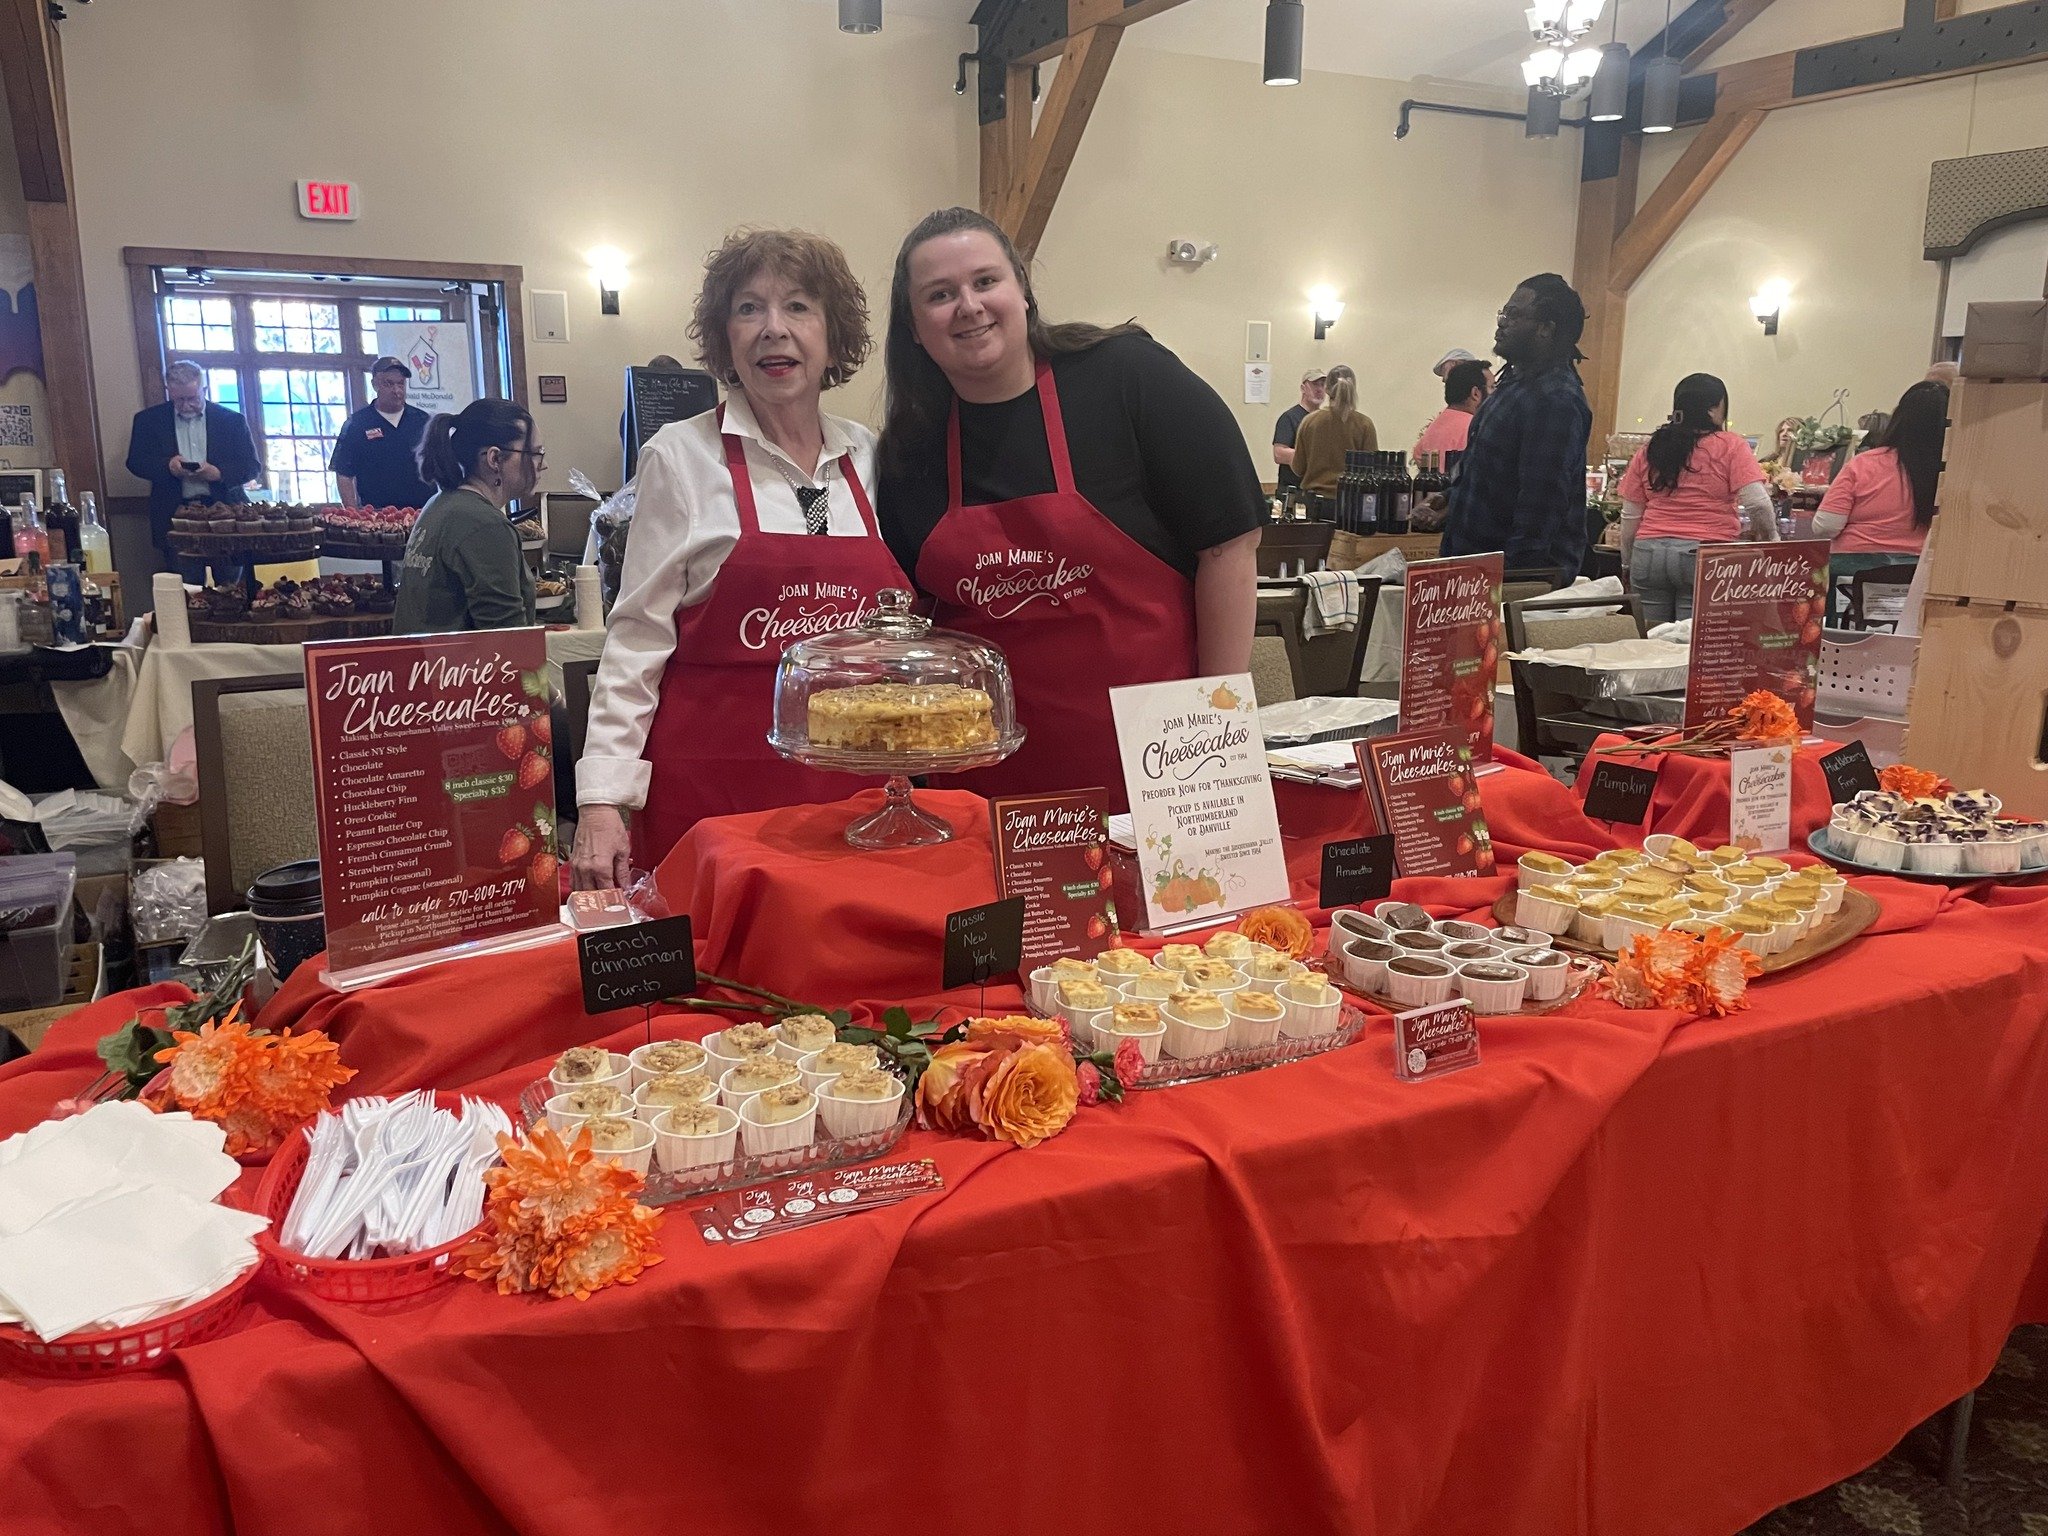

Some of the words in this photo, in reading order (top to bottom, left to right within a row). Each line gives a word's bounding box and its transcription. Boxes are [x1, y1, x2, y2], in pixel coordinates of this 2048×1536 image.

[307, 182, 349, 215] EXIT
[1705, 558, 1742, 581] Joan
[1749, 555, 1812, 578] Marie's
[956, 557, 1094, 606] Cheesecakes
[1412, 580, 1440, 605] Joan
[1444, 573, 1490, 600] Marie's
[1711, 576, 1809, 602] Cheesecakes
[1416, 596, 1489, 629] Cheesecakes
[326, 662, 394, 700] Joan
[408, 652, 519, 691] Marie's
[343, 686, 519, 734] Cheesecakes
[341, 734, 369, 742] Making
[432, 724, 453, 732] Valley
[454, 721, 481, 730] Sweeter
[482, 720, 500, 728] Since
[340, 749, 370, 760] Classic
[371, 746, 385, 757] NY
[387, 744, 408, 755] Style
[1142, 720, 1250, 779] Cheesecakes
[1381, 750, 1406, 768] Joan
[1410, 742, 1455, 763] Marie's
[340, 761, 384, 773] Chocolate
[341, 775, 384, 786] Chocolate
[386, 769, 425, 780] Amaretto
[1389, 757, 1457, 783] Cheesecakes
[342, 787, 385, 799] Chocolate
[386, 784, 407, 793] Chip
[445, 781, 451, 790] 8
[452, 780, 470, 789] inch
[471, 776, 497, 786] classic
[498, 773, 514, 783] $30
[453, 788, 489, 801] Specialty
[490, 785, 506, 795] $35
[1596, 770, 1647, 797] Pumpkin
[343, 799, 396, 813] Huckleberry
[398, 796, 418, 805] Finn
[344, 816, 366, 825] Oreo
[368, 811, 397, 821] Cookie
[345, 828, 376, 838] Peanut
[378, 822, 404, 833] Butter
[405, 820, 423, 830] Cup
[1005, 810, 1037, 831] Joan
[1043, 805, 1098, 826] Marie's
[346, 839, 385, 851] Espresso
[386, 832, 427, 845] Chocolate
[428, 828, 448, 838] Chip
[1013, 823, 1098, 849] Cheesecakes
[347, 852, 378, 864] French
[380, 845, 423, 859] Cinnamon
[424, 839, 452, 851] Crumb
[1328, 842, 1372, 859] Chocolate
[348, 863, 395, 877] Strawberry
[396, 857, 419, 868] Swirl
[349, 876, 388, 890] Pumpkin
[390, 867, 432, 883] (seasonal)
[1336, 865, 1373, 877] Amaretto
[350, 889, 389, 903] Pumpkin
[390, 883, 421, 894] Cognac
[422, 875, 463, 890] (seasonal)
[361, 904, 388, 923] call
[391, 902, 404, 920] to
[408, 896, 443, 914] order
[375, 923, 400, 932] Please
[400, 919, 420, 927] allow
[450, 908, 472, 917] notice
[473, 904, 483, 912] for
[484, 901, 493, 909] all
[494, 898, 516, 907] orders
[949, 910, 985, 932] Classic
[377, 939, 399, 948] about
[464, 922, 478, 931] and
[478, 917, 504, 927] custom
[380, 929, 405, 940] Pickup
[415, 915, 475, 932] Northumberland
[485, 906, 514, 918] Danville
[584, 931, 658, 957] French
[963, 931, 987, 948] New
[973, 947, 998, 967] York
